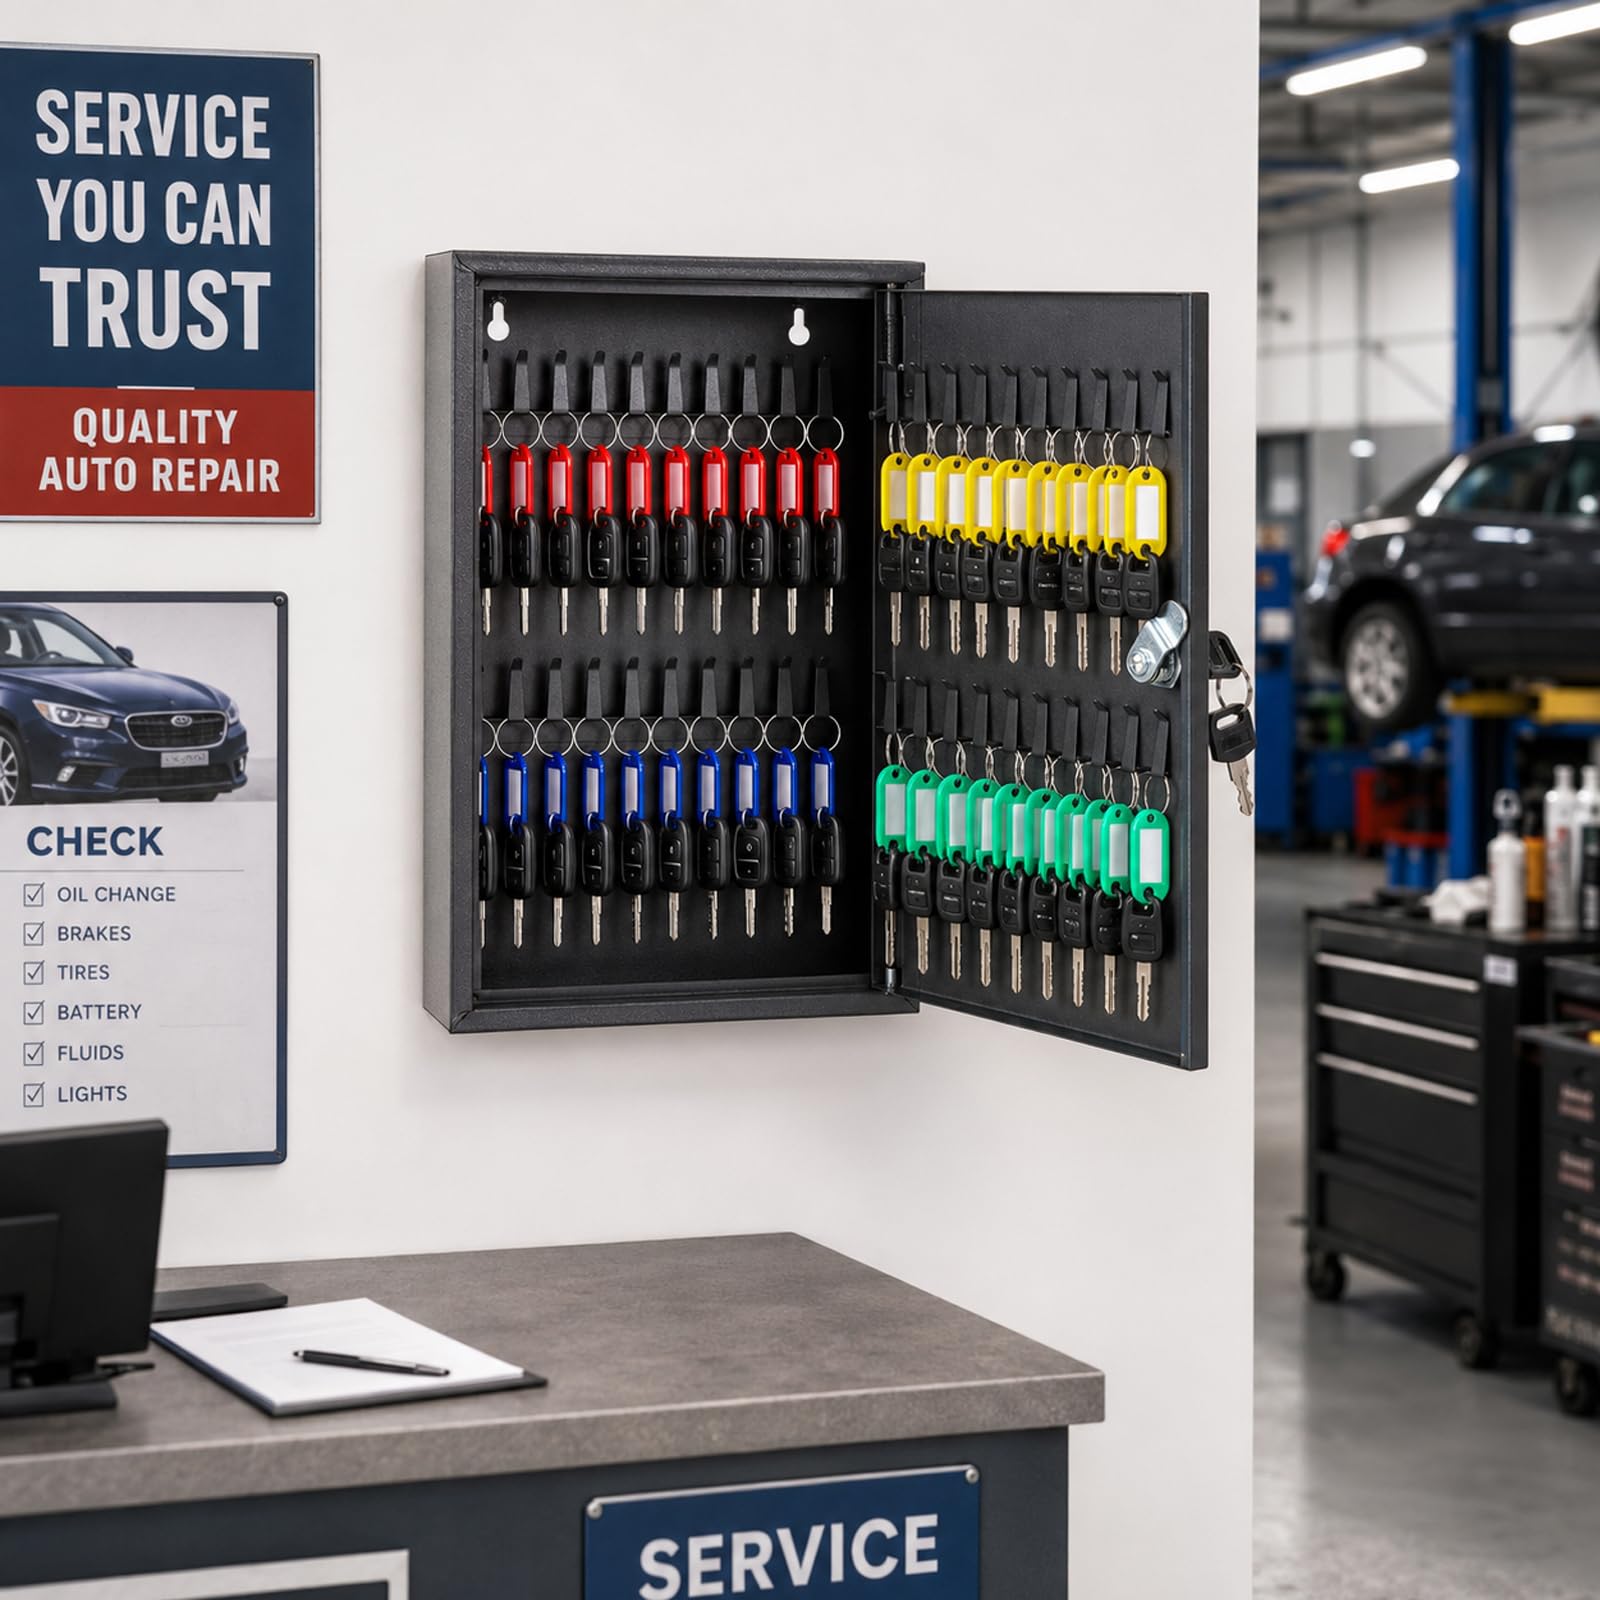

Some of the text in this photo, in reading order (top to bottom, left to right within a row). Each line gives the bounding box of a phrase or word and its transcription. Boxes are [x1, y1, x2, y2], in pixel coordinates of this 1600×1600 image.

[36, 89, 270, 159] SERVICE
[37, 179, 270, 245] YOU CAN
[40, 267, 270, 350] TRUST
[74, 408, 237, 447] QUALITY
[39, 457, 279, 492] AUTO REPAIR
[27, 826, 163, 856] CHECK
[58, 887, 175, 902] OIL CHANGE
[58, 926, 131, 941] BRAKES
[57, 965, 109, 980] TIRES
[58, 1004, 141, 1020] BATTERY
[58, 1045, 123, 1061] FLUIDS
[59, 1086, 127, 1102] LIGHTS
[640, 1514, 937, 1600] SERVICE
